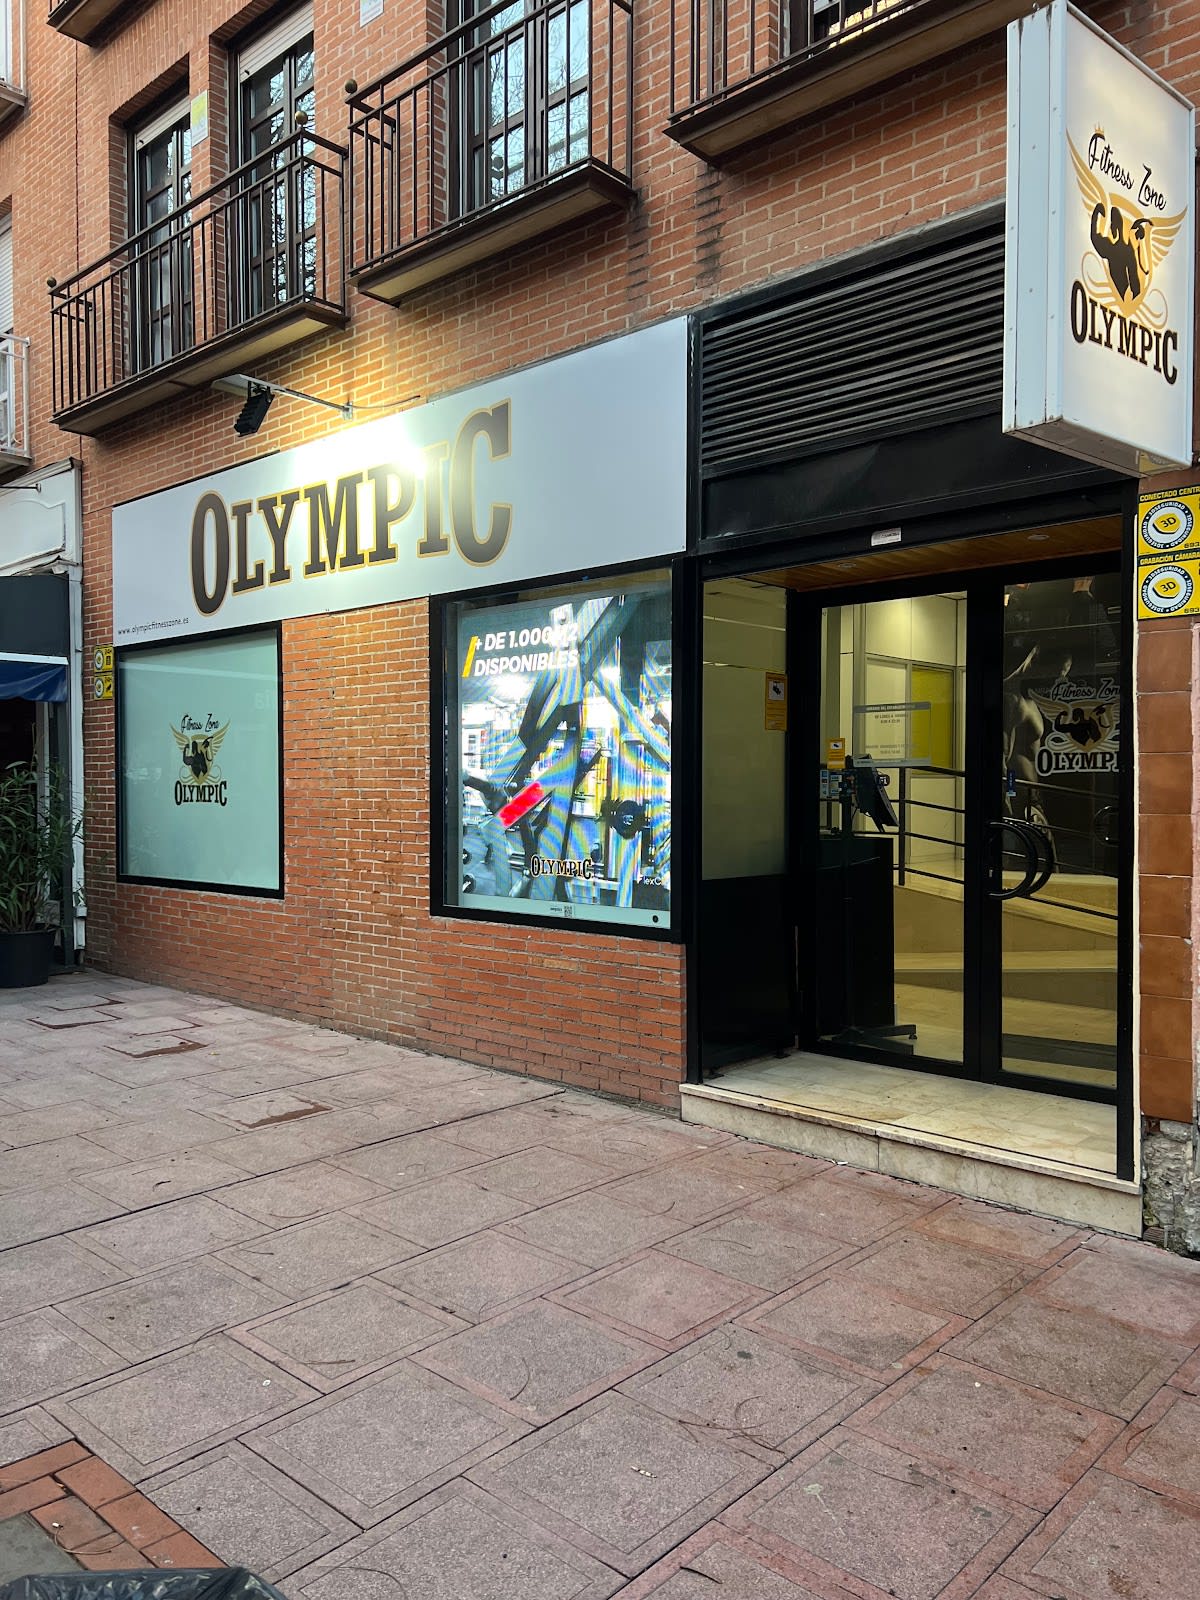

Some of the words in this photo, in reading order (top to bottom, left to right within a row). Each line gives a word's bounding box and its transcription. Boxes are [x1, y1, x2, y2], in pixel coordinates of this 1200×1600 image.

[1088, 132, 1134, 190] Fitness
[1137, 163, 1167, 211] Zone
[1070, 279, 1178, 385] OLYMPIC
[1139, 489, 1178, 502] CONECTADO
[191, 398, 512, 617] OLYMPIC
[1160, 517, 1176, 528] 3D
[1160, 581, 1176, 593] 3D
[117, 617, 189, 635] www.olympicfitnesszone.es
[484, 631, 505, 651] DE
[474, 650, 579, 677] DISPONIBLES
[1052, 682, 1094, 701] Fitness
[205, 713, 220, 732] Zone
[174, 780, 228, 806] OLYMPIC
[531, 854, 593, 880] OLYMPIC
